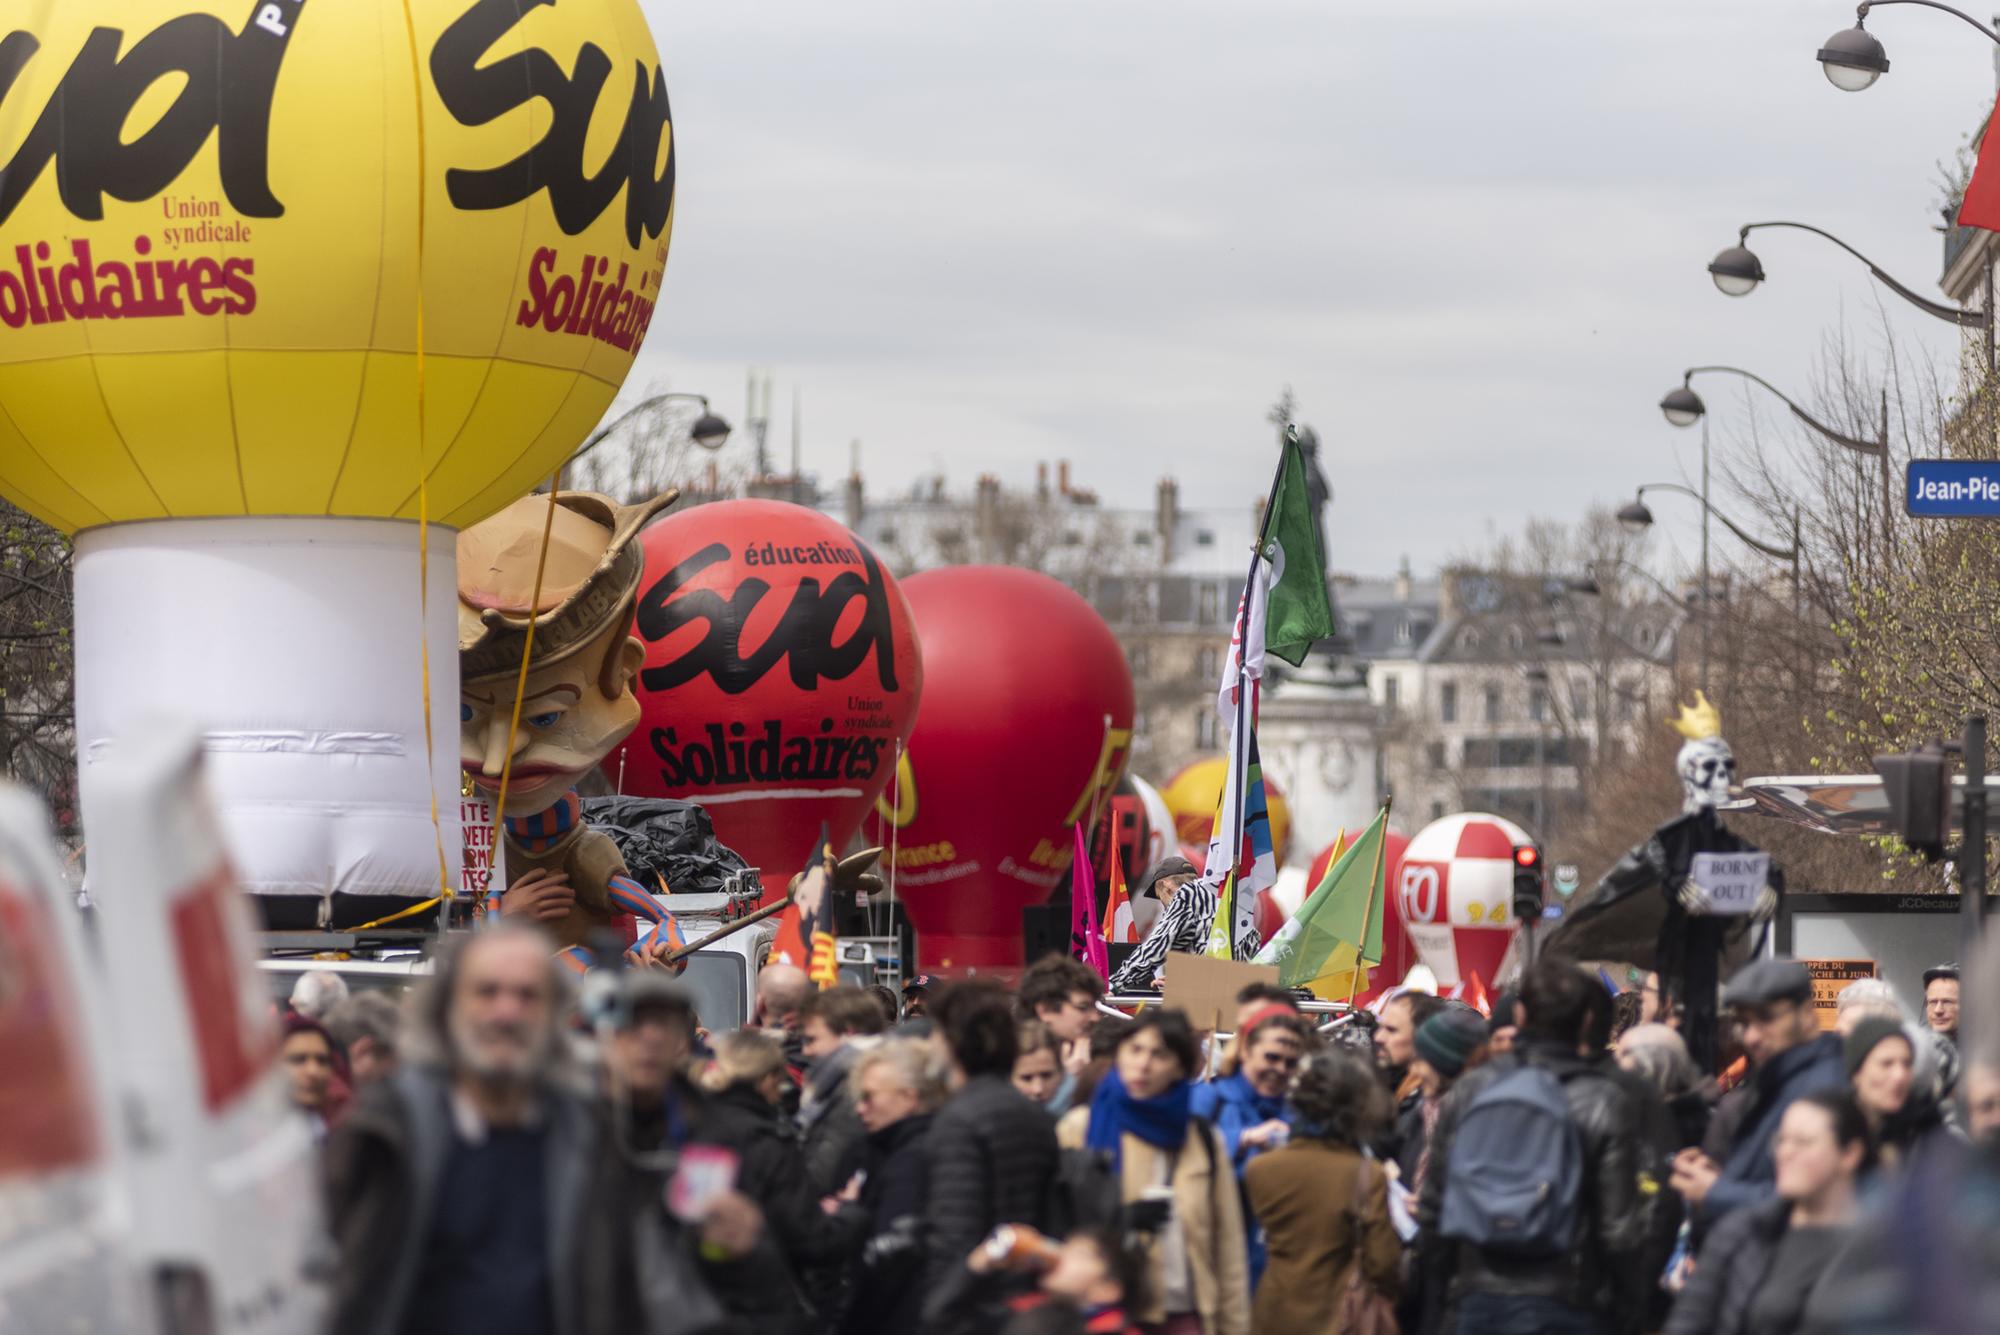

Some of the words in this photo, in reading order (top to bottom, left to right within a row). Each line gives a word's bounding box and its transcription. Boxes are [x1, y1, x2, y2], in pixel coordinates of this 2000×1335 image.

[162, 196, 220, 219] Union
[164, 220, 251, 249] syndicale
[745, 542, 861, 567] éducation
[848, 696, 883, 711] Union
[843, 714, 893, 731] syndicale
[650, 717, 887, 788] Solidaires
[1711, 860, 1760, 875] BORNE
[1401, 866, 1440, 924] FO
[1713, 885, 1747, 900] OUT
[1467, 901, 1506, 924] 94
[1808, 971, 1834, 979] NCHE
[1832, 961, 1845, 970] DU
